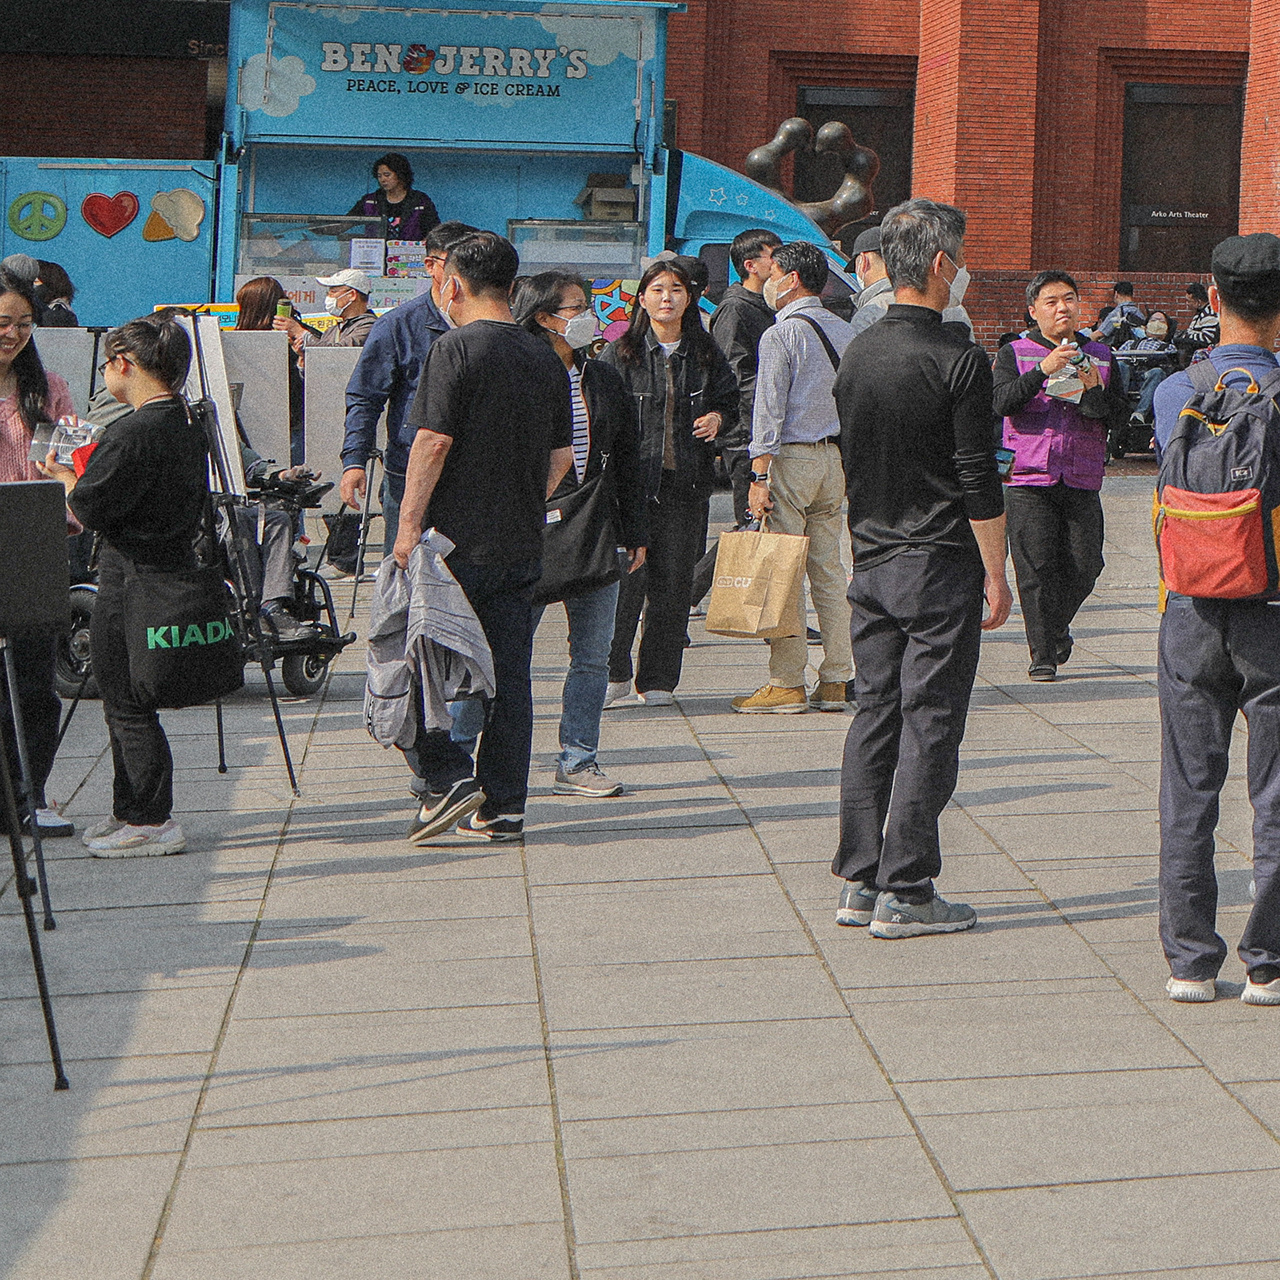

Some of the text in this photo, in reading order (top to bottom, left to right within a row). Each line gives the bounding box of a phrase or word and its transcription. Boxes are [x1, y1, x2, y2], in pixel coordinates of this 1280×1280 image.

[321, 42, 402, 73] BEN
[434, 45, 588, 78] JERRY'S
[346, 79, 401, 94] PEACE,
[407, 81, 449, 94] LOVE
[473, 82, 498, 95] ICE
[504, 83, 561, 97] CREAM
[1151, 210, 1209, 219] Arko Arts Theater
